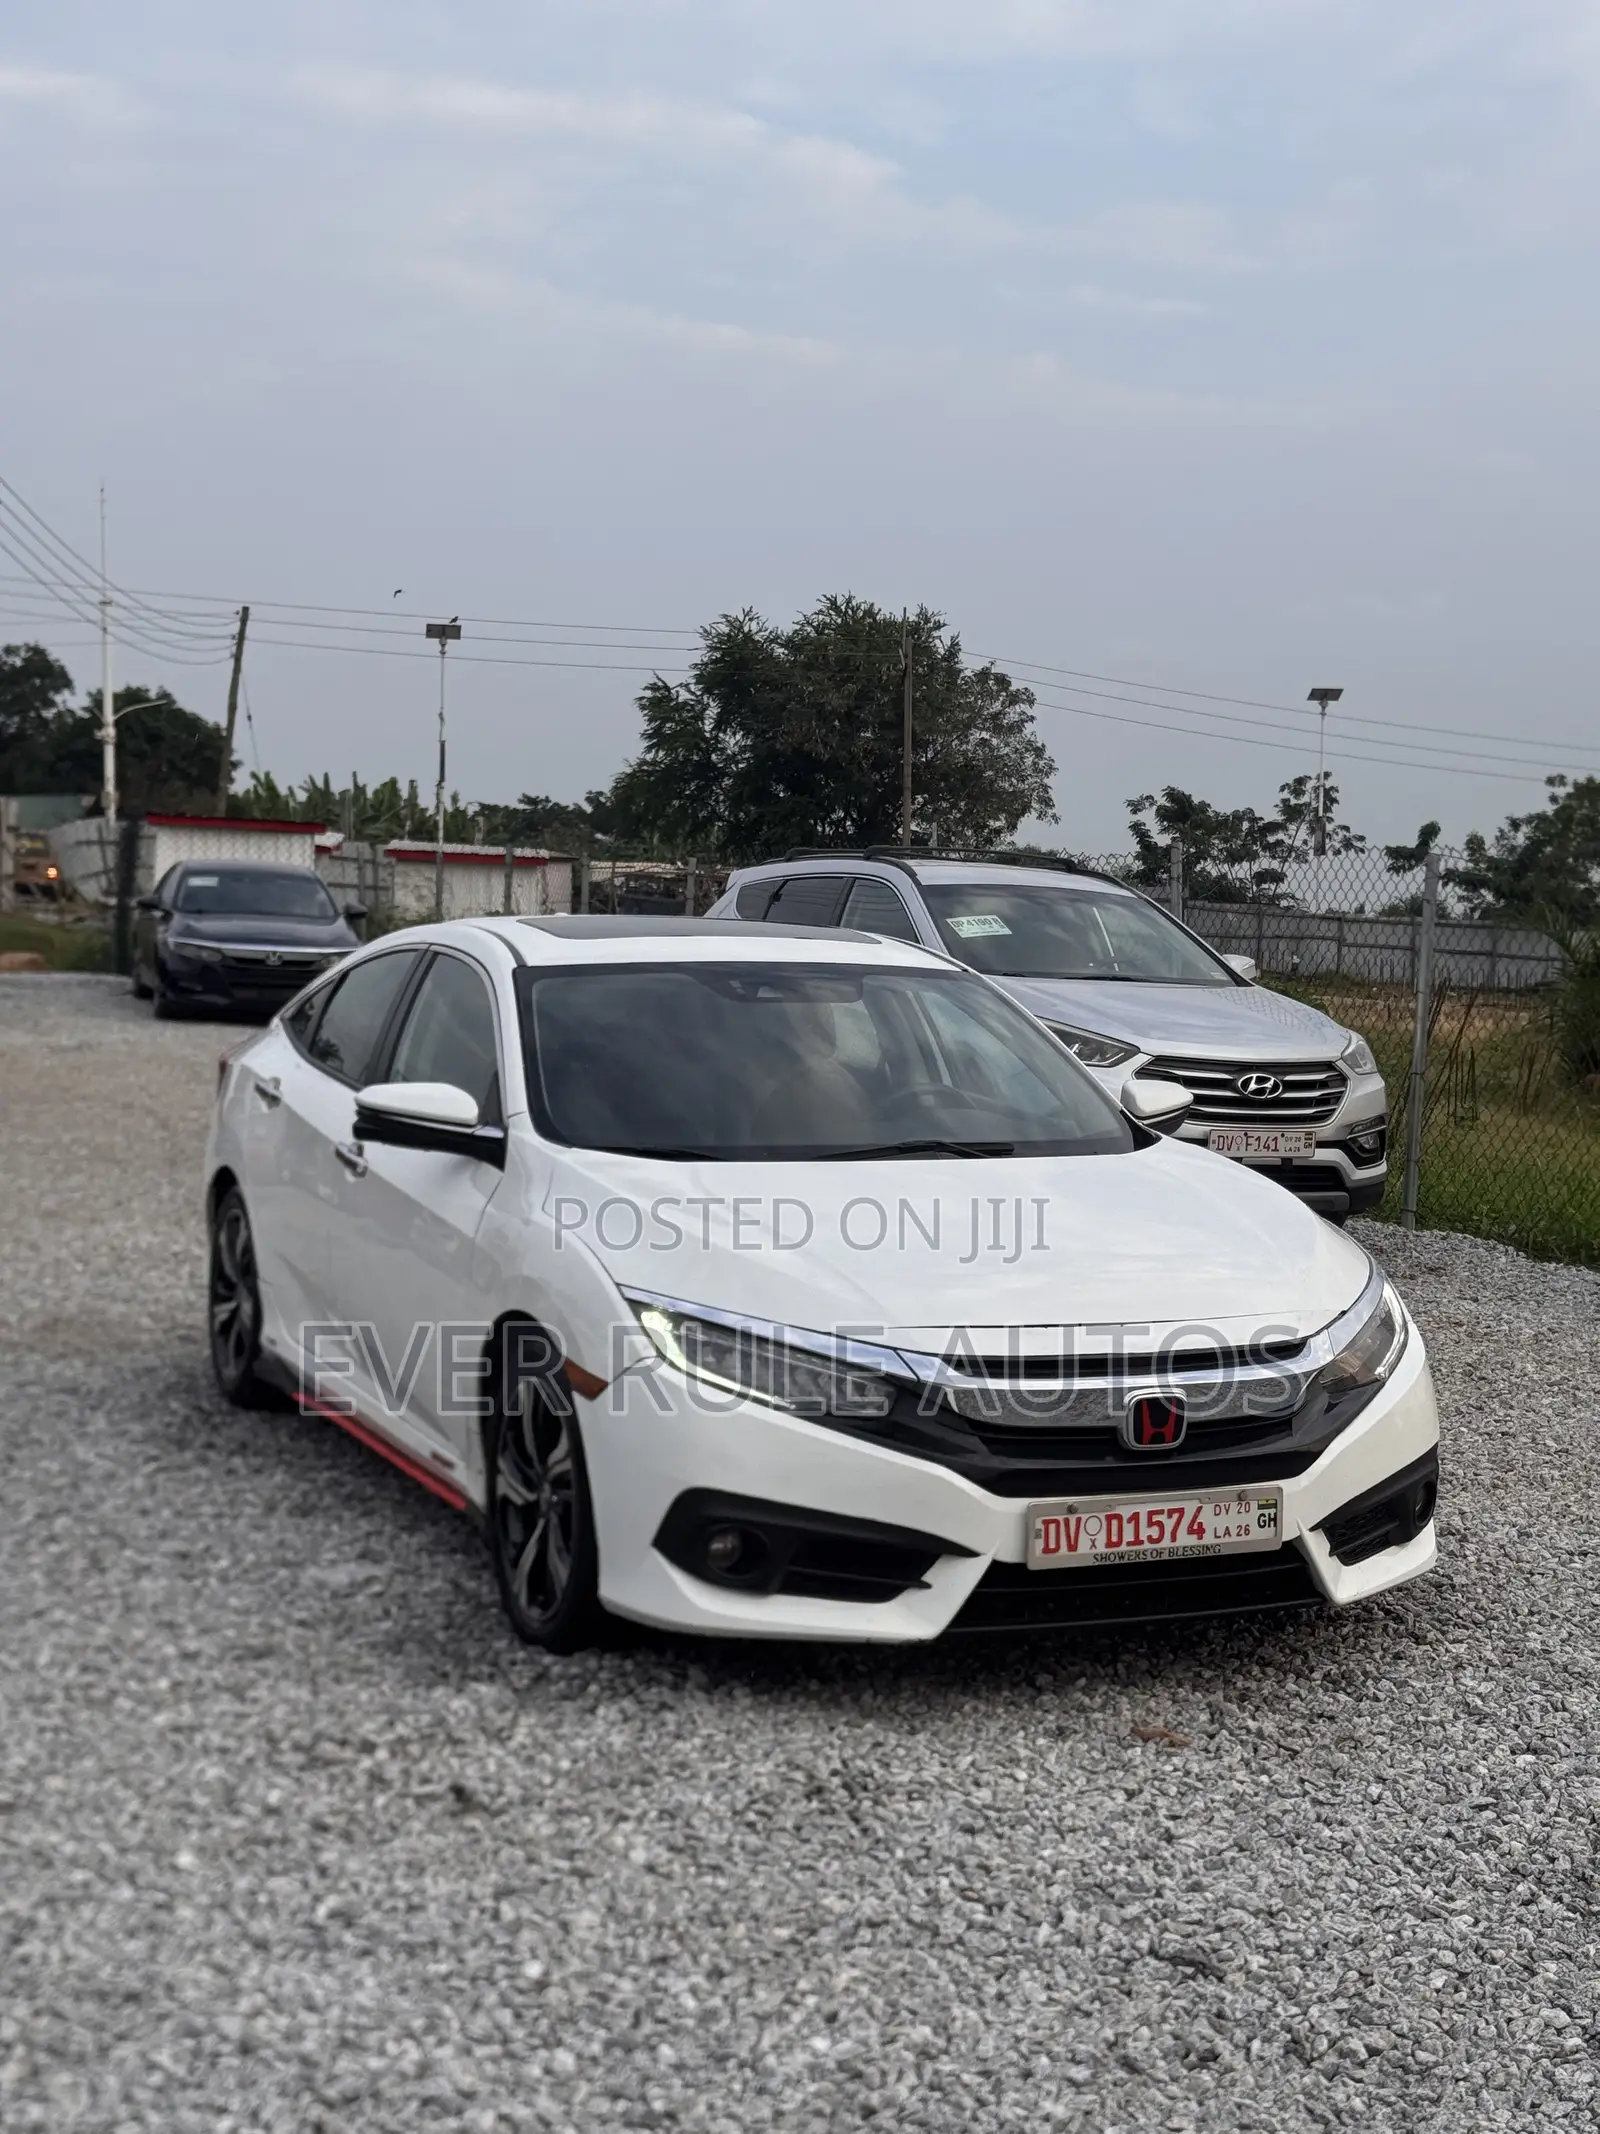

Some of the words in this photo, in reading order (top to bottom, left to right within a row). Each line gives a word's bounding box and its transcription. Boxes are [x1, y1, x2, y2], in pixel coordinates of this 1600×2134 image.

[1216, 1135, 1235, 1152] DV
[1245, 1135, 1280, 1152] F141
[1214, 1503, 1231, 1516] DV
[1236, 1502, 1251, 1514] 20
[1257, 1512, 1277, 1529] GH
[1042, 1516, 1082, 1555] DV
[1105, 1505, 1206, 1549] D1574
[1214, 1526, 1231, 1538] LA
[1236, 1524, 1251, 1536] 26
[1093, 1550, 1148, 1563] SHOWERS
[1150, 1548, 1164, 1560] OF
[1168, 1544, 1221, 1558] BLESSING
